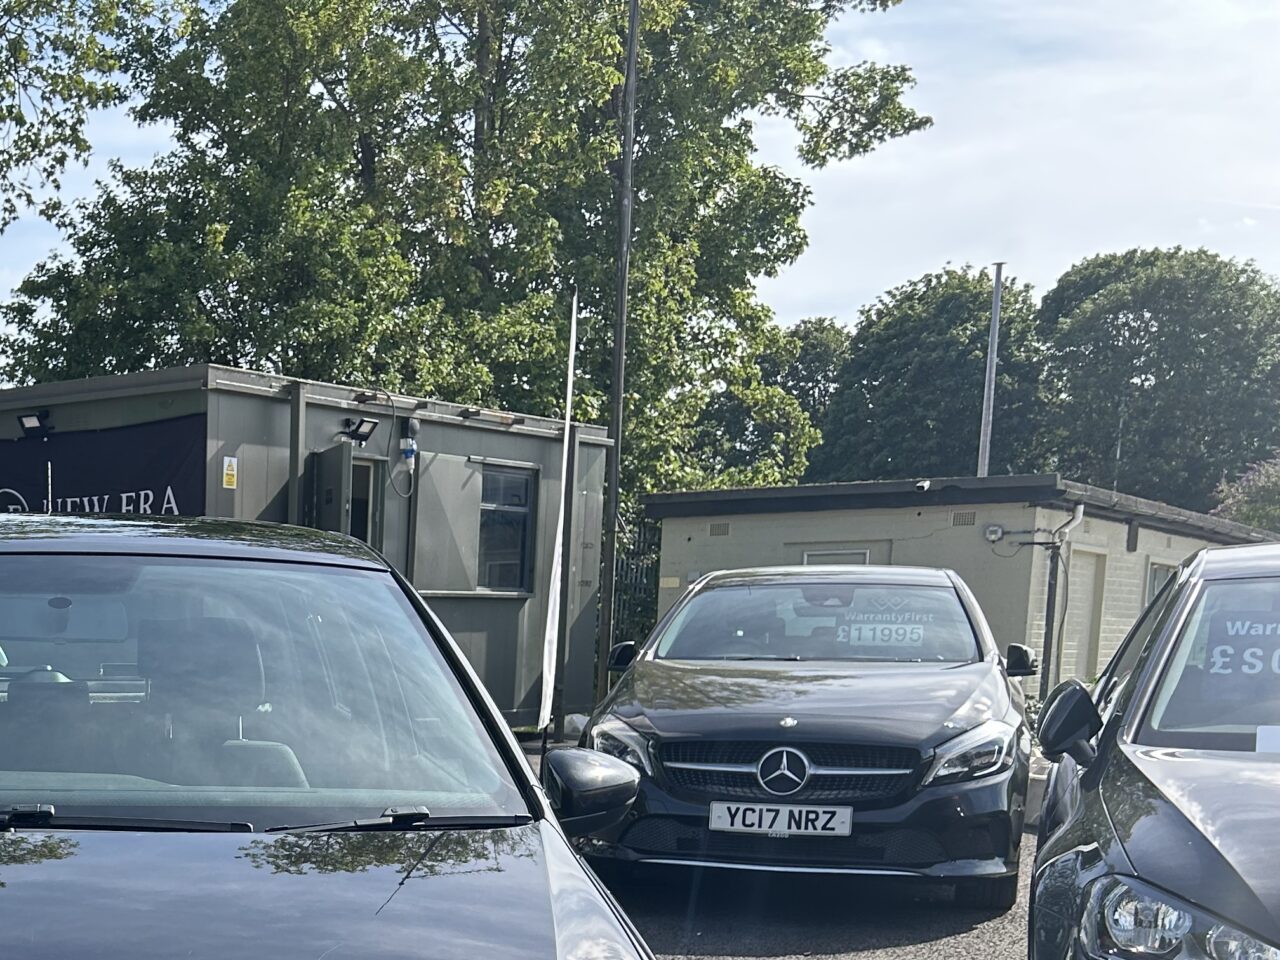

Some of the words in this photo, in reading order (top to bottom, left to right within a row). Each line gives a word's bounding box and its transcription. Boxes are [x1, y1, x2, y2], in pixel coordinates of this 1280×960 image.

[843, 611, 934, 624] WarrantyFirst
[1226, 620, 1280, 636] War
[726, 806, 780, 829] YC17
[787, 809, 837, 832] NRZ
